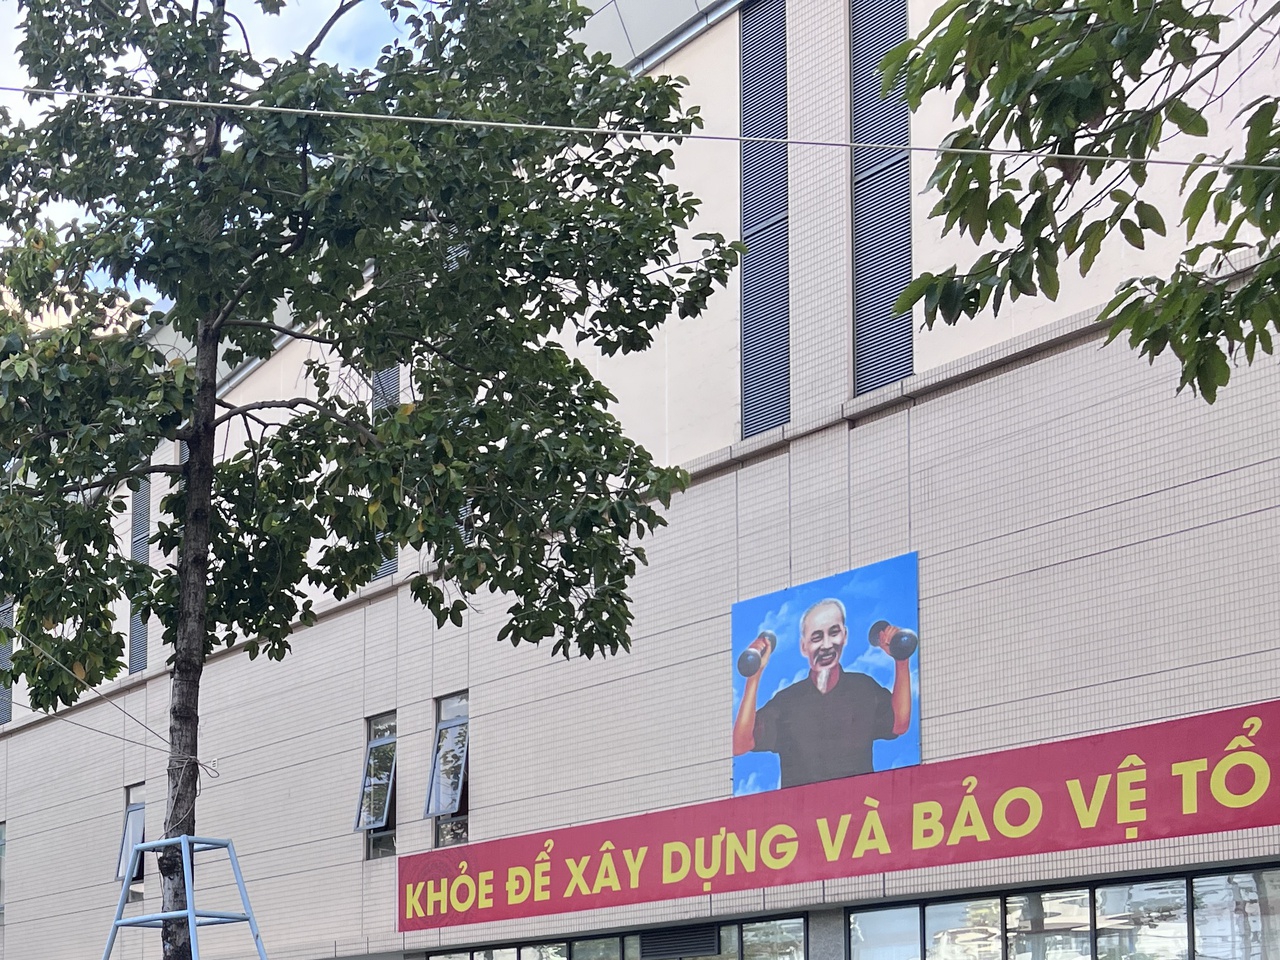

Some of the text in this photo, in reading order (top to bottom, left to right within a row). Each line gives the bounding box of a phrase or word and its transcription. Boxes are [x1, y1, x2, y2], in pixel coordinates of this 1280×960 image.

[405, 716, 1272, 919] KHỎE ĐỂ XÂY DỰNG VÀ BẢO VỆ TỔ
